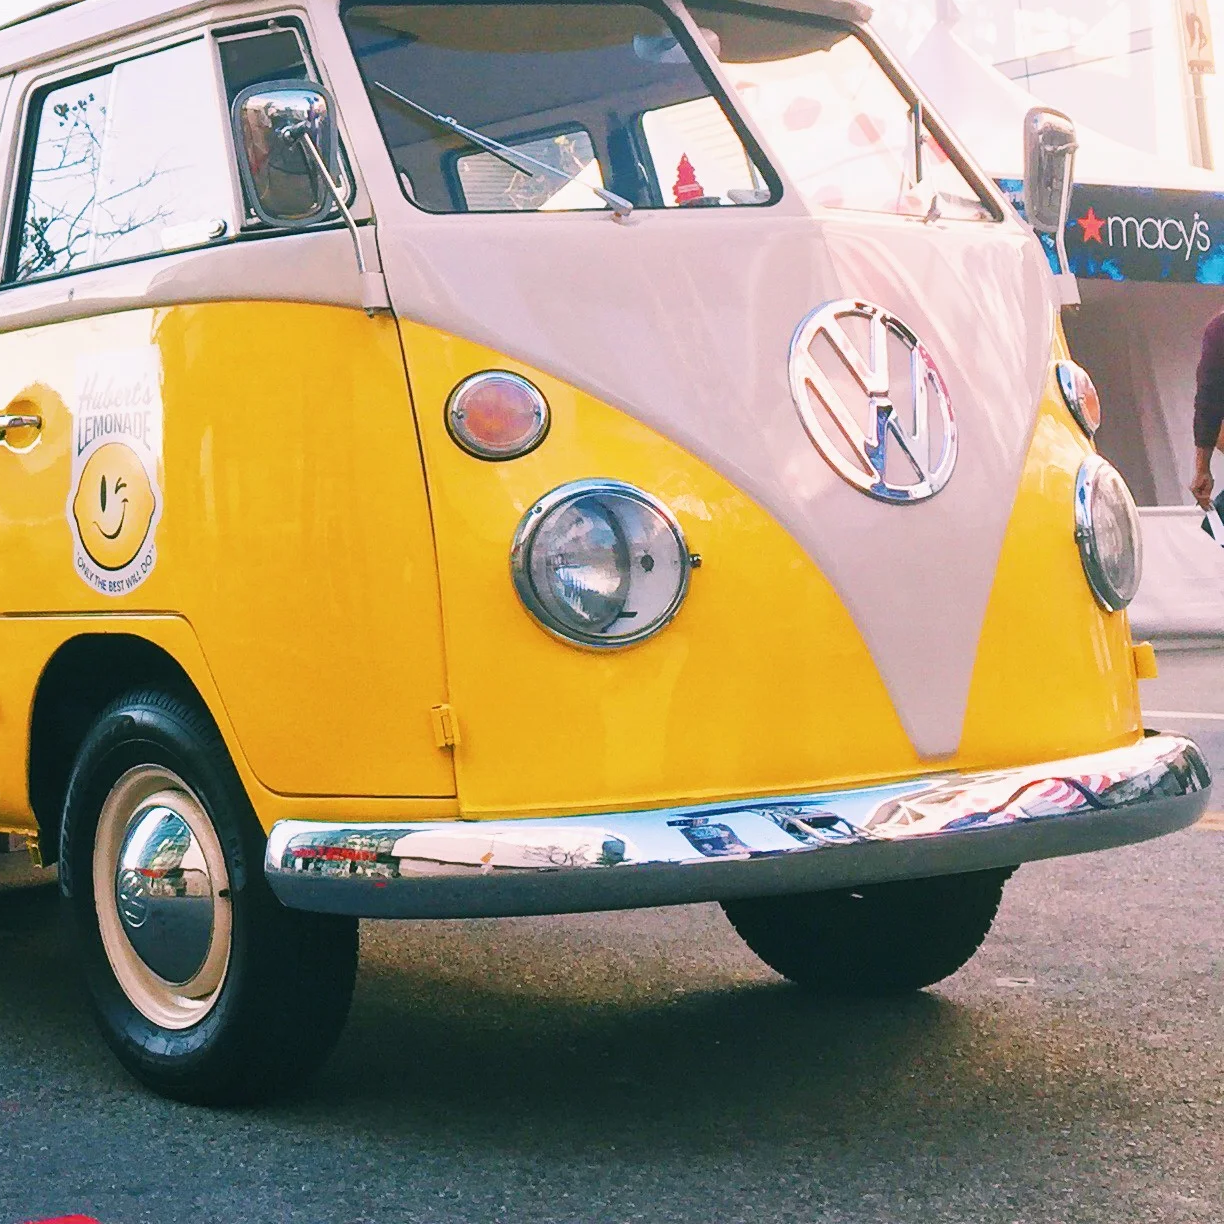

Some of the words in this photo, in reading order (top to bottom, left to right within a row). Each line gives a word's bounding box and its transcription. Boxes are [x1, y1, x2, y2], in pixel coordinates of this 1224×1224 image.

[1108, 212, 1210, 261] macy's
[78, 371, 155, 413] Hubert's
[77, 410, 152, 457] LEMONADE
[94, 574, 107, 592] THE
[108, 579, 125, 592] BEST
